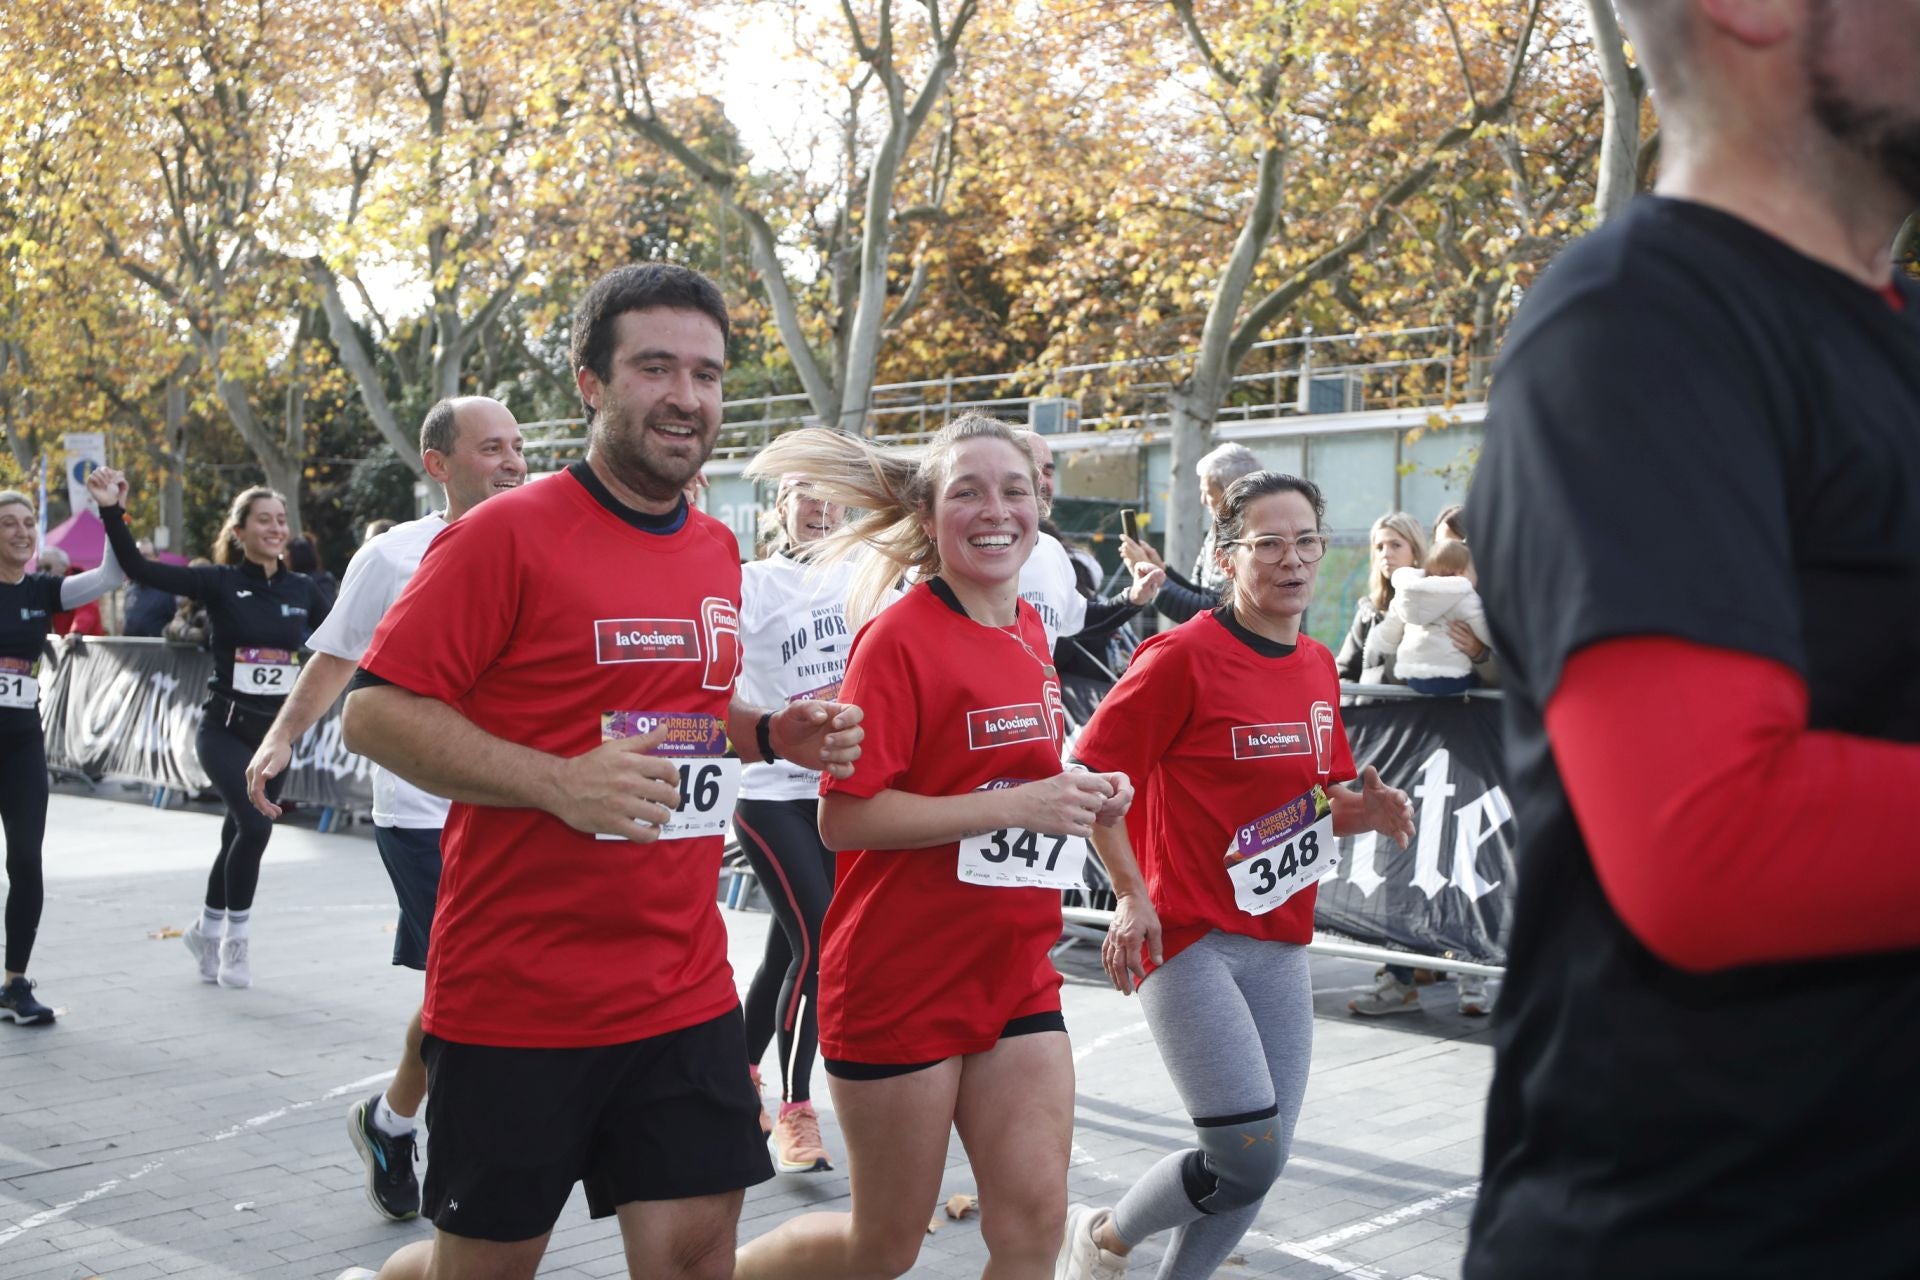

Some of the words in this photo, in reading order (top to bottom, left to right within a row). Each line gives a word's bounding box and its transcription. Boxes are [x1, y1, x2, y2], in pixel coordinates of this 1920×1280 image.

[781, 627, 807, 665] RIO
[252, 667, 283, 686] 62
[699, 718, 709, 729] DE
[1256, 809, 1288, 830] CARRERA
[1287, 804, 1297, 817] DE
[1258, 813, 1299, 839] EMPRESAS
[980, 827, 1068, 872] 347
[1249, 830, 1320, 896] 348
